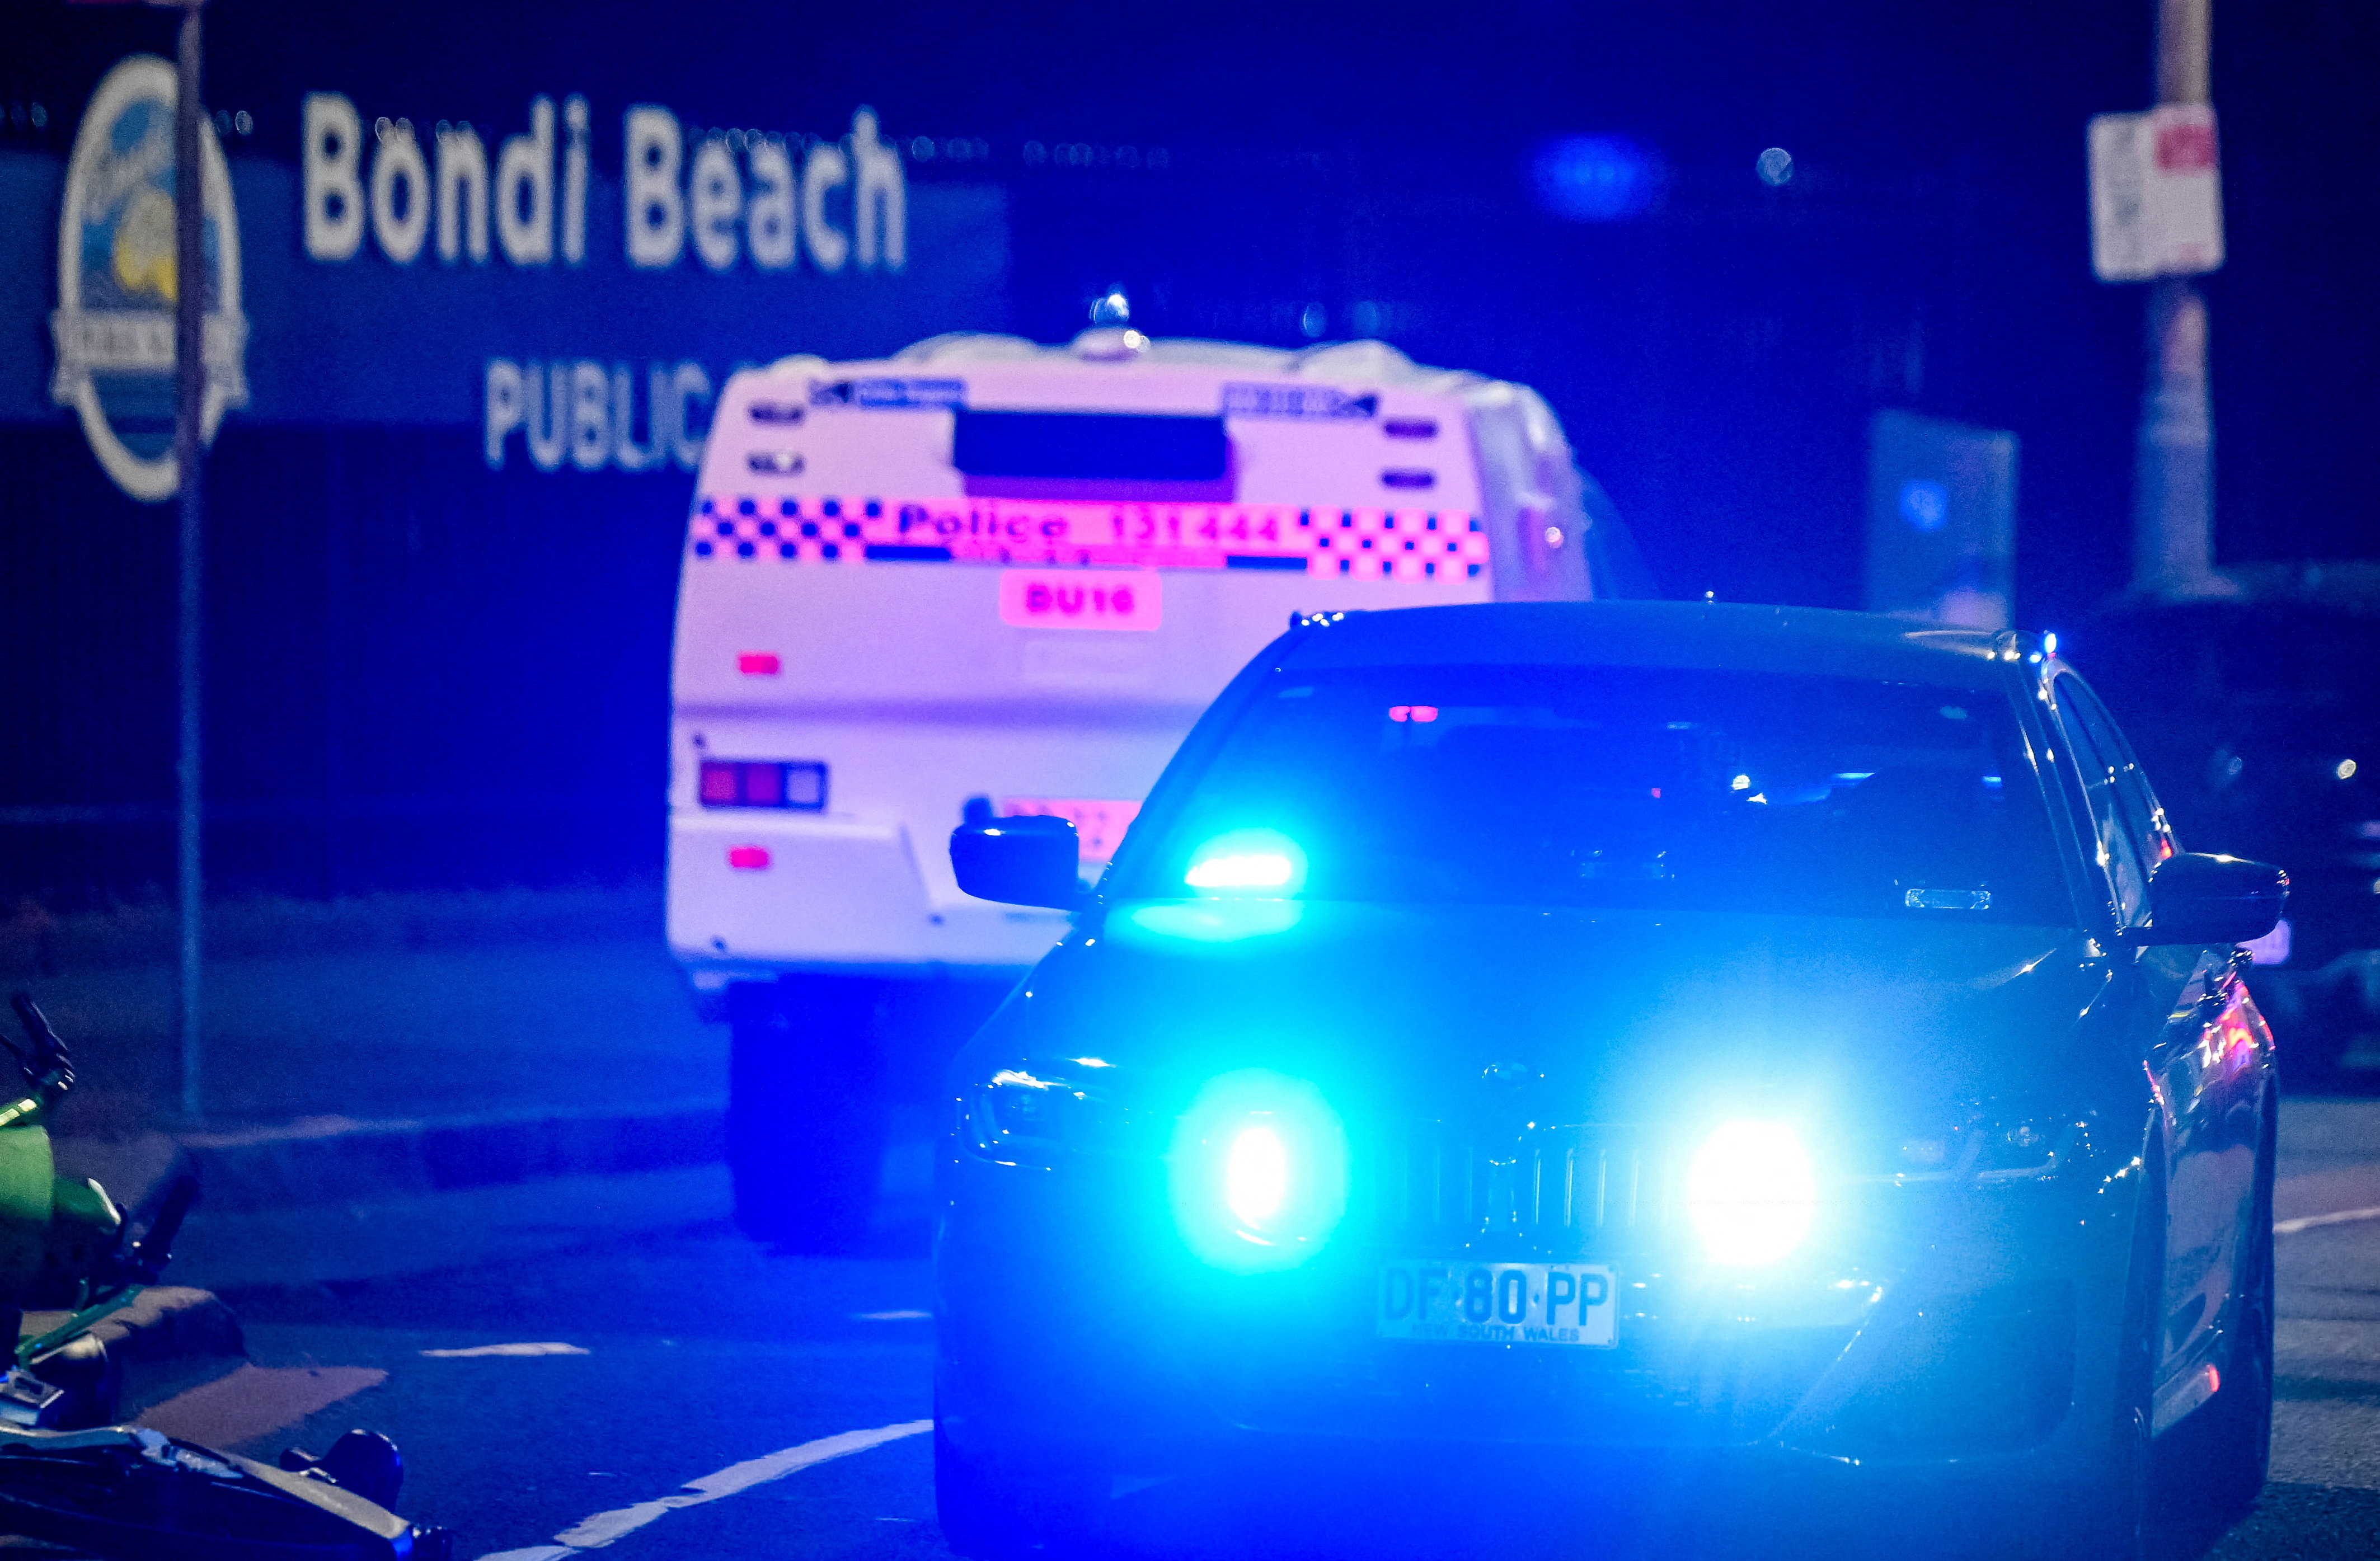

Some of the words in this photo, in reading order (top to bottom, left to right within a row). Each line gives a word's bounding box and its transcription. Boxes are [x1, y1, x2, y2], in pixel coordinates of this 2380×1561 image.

[302, 94, 589, 266] Bondi
[623, 105, 907, 270] Beach
[485, 358, 711, 471] PUBLIC
[896, 501, 1068, 542] Police
[1457, 1324, 1514, 1341] SOUTH
[1524, 1327, 1579, 1342] WALES
